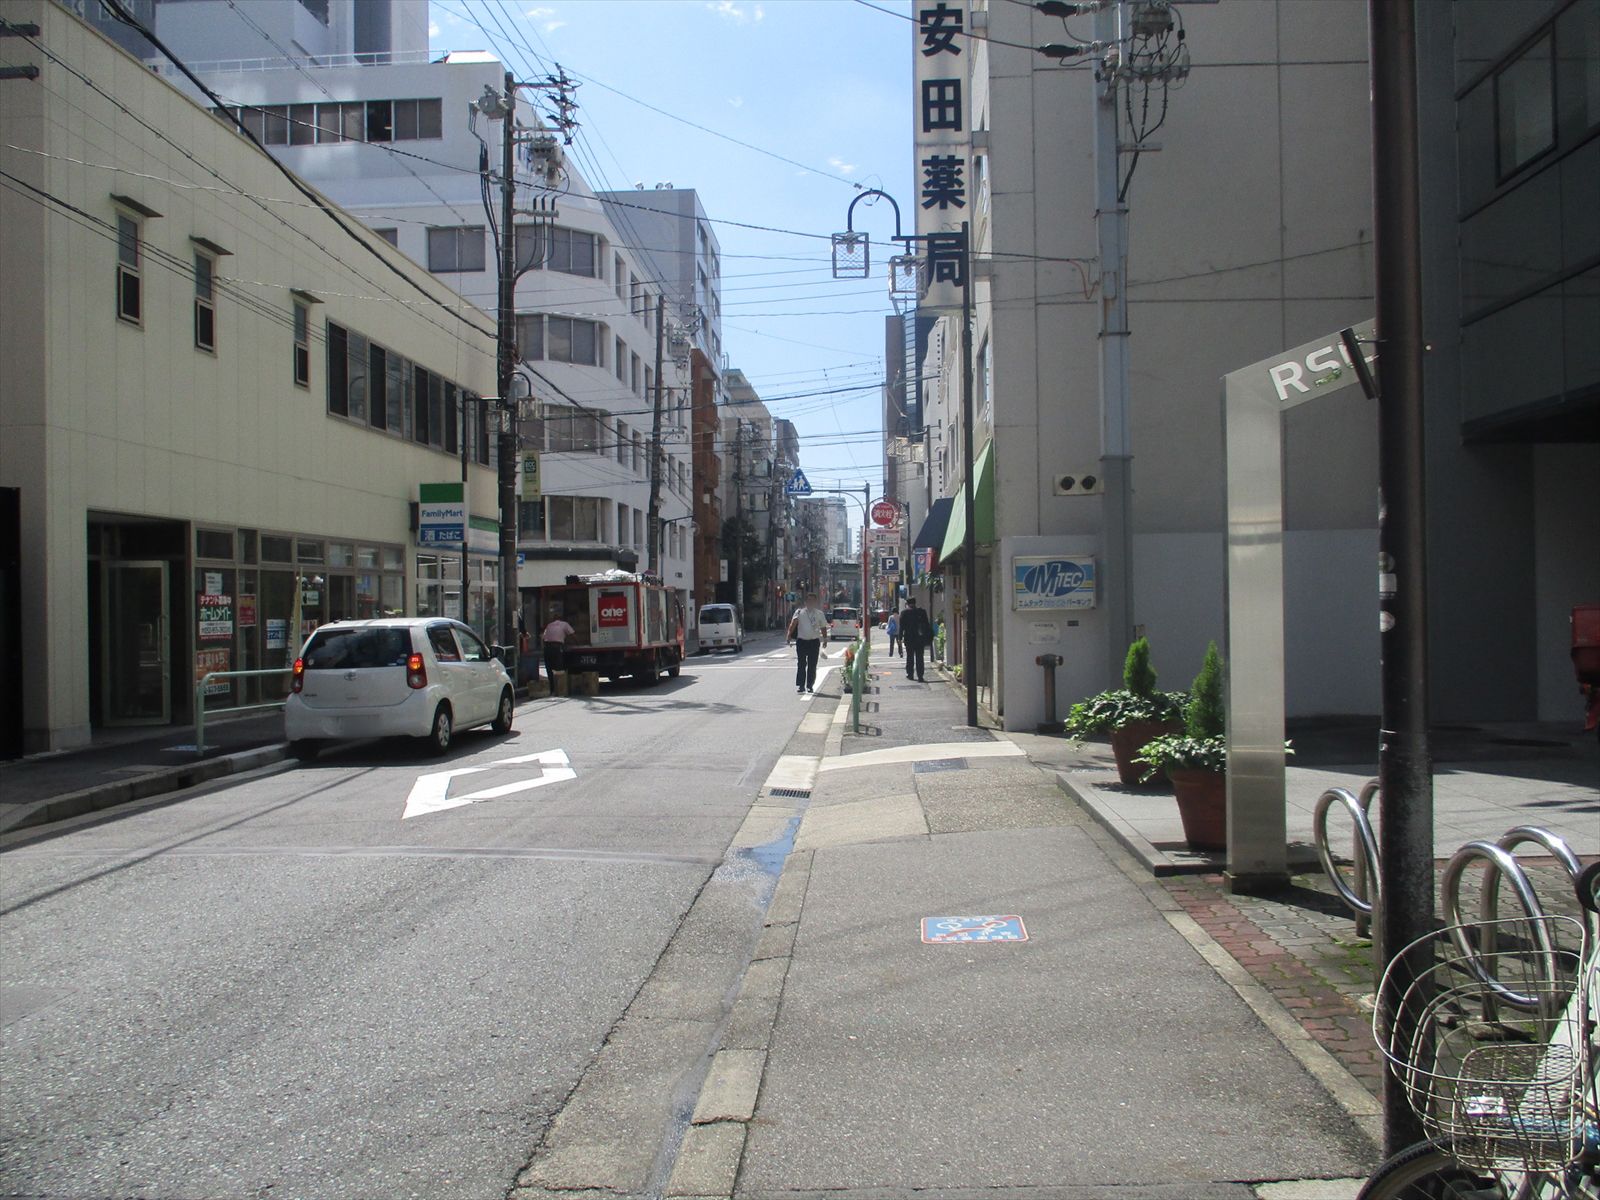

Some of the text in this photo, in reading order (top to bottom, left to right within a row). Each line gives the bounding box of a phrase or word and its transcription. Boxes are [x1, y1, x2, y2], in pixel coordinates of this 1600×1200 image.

[920, 3, 966, 294] 安田薬局
[421, 509, 463, 519] FamilyMart
[439, 530, 461, 540] たばこ
[886, 559, 894, 570] P
